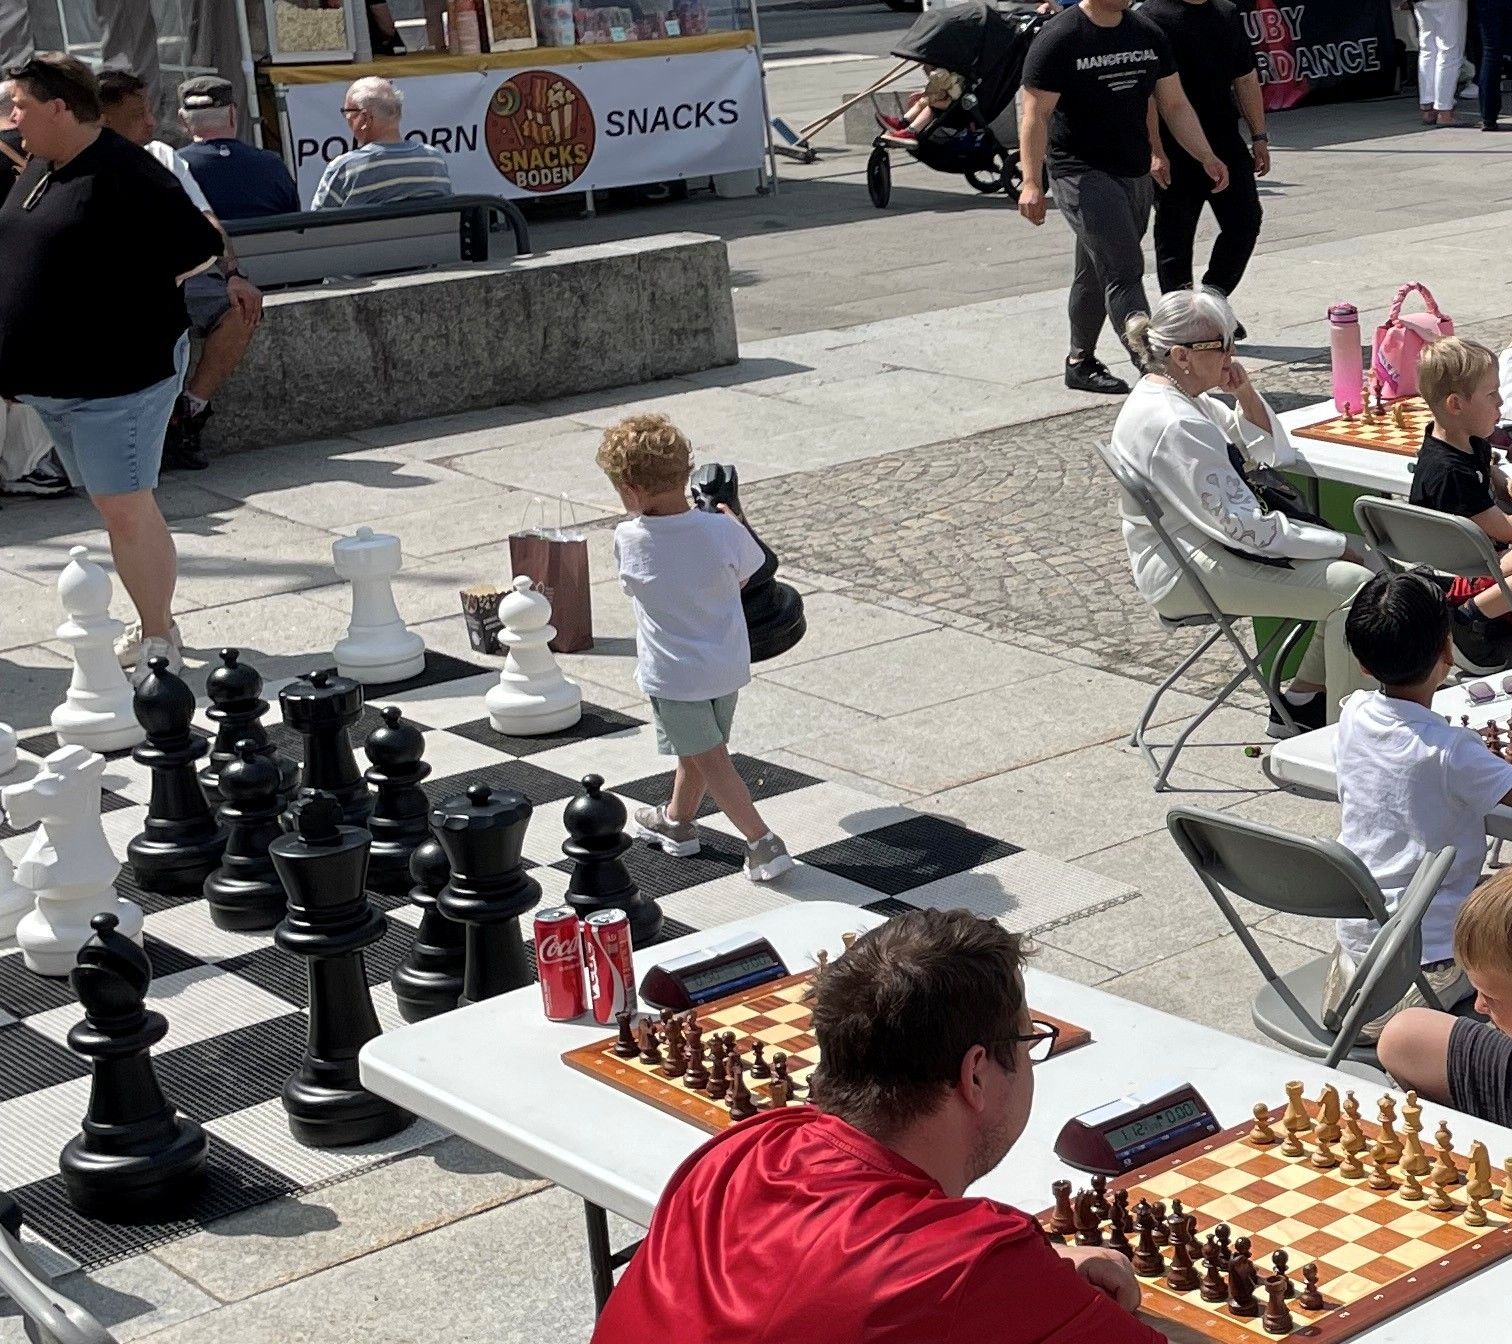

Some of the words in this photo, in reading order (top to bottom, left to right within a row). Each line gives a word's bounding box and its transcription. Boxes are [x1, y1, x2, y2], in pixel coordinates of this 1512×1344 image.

[1240, 5, 1305, 46] UBY
[1255, 37, 1381, 87] RDANCE
[298, 124, 478, 167] POORN
[605, 99, 739, 137] SNACKS
[499, 142, 588, 171] SNACKS
[515, 166, 574, 187] BODEN
